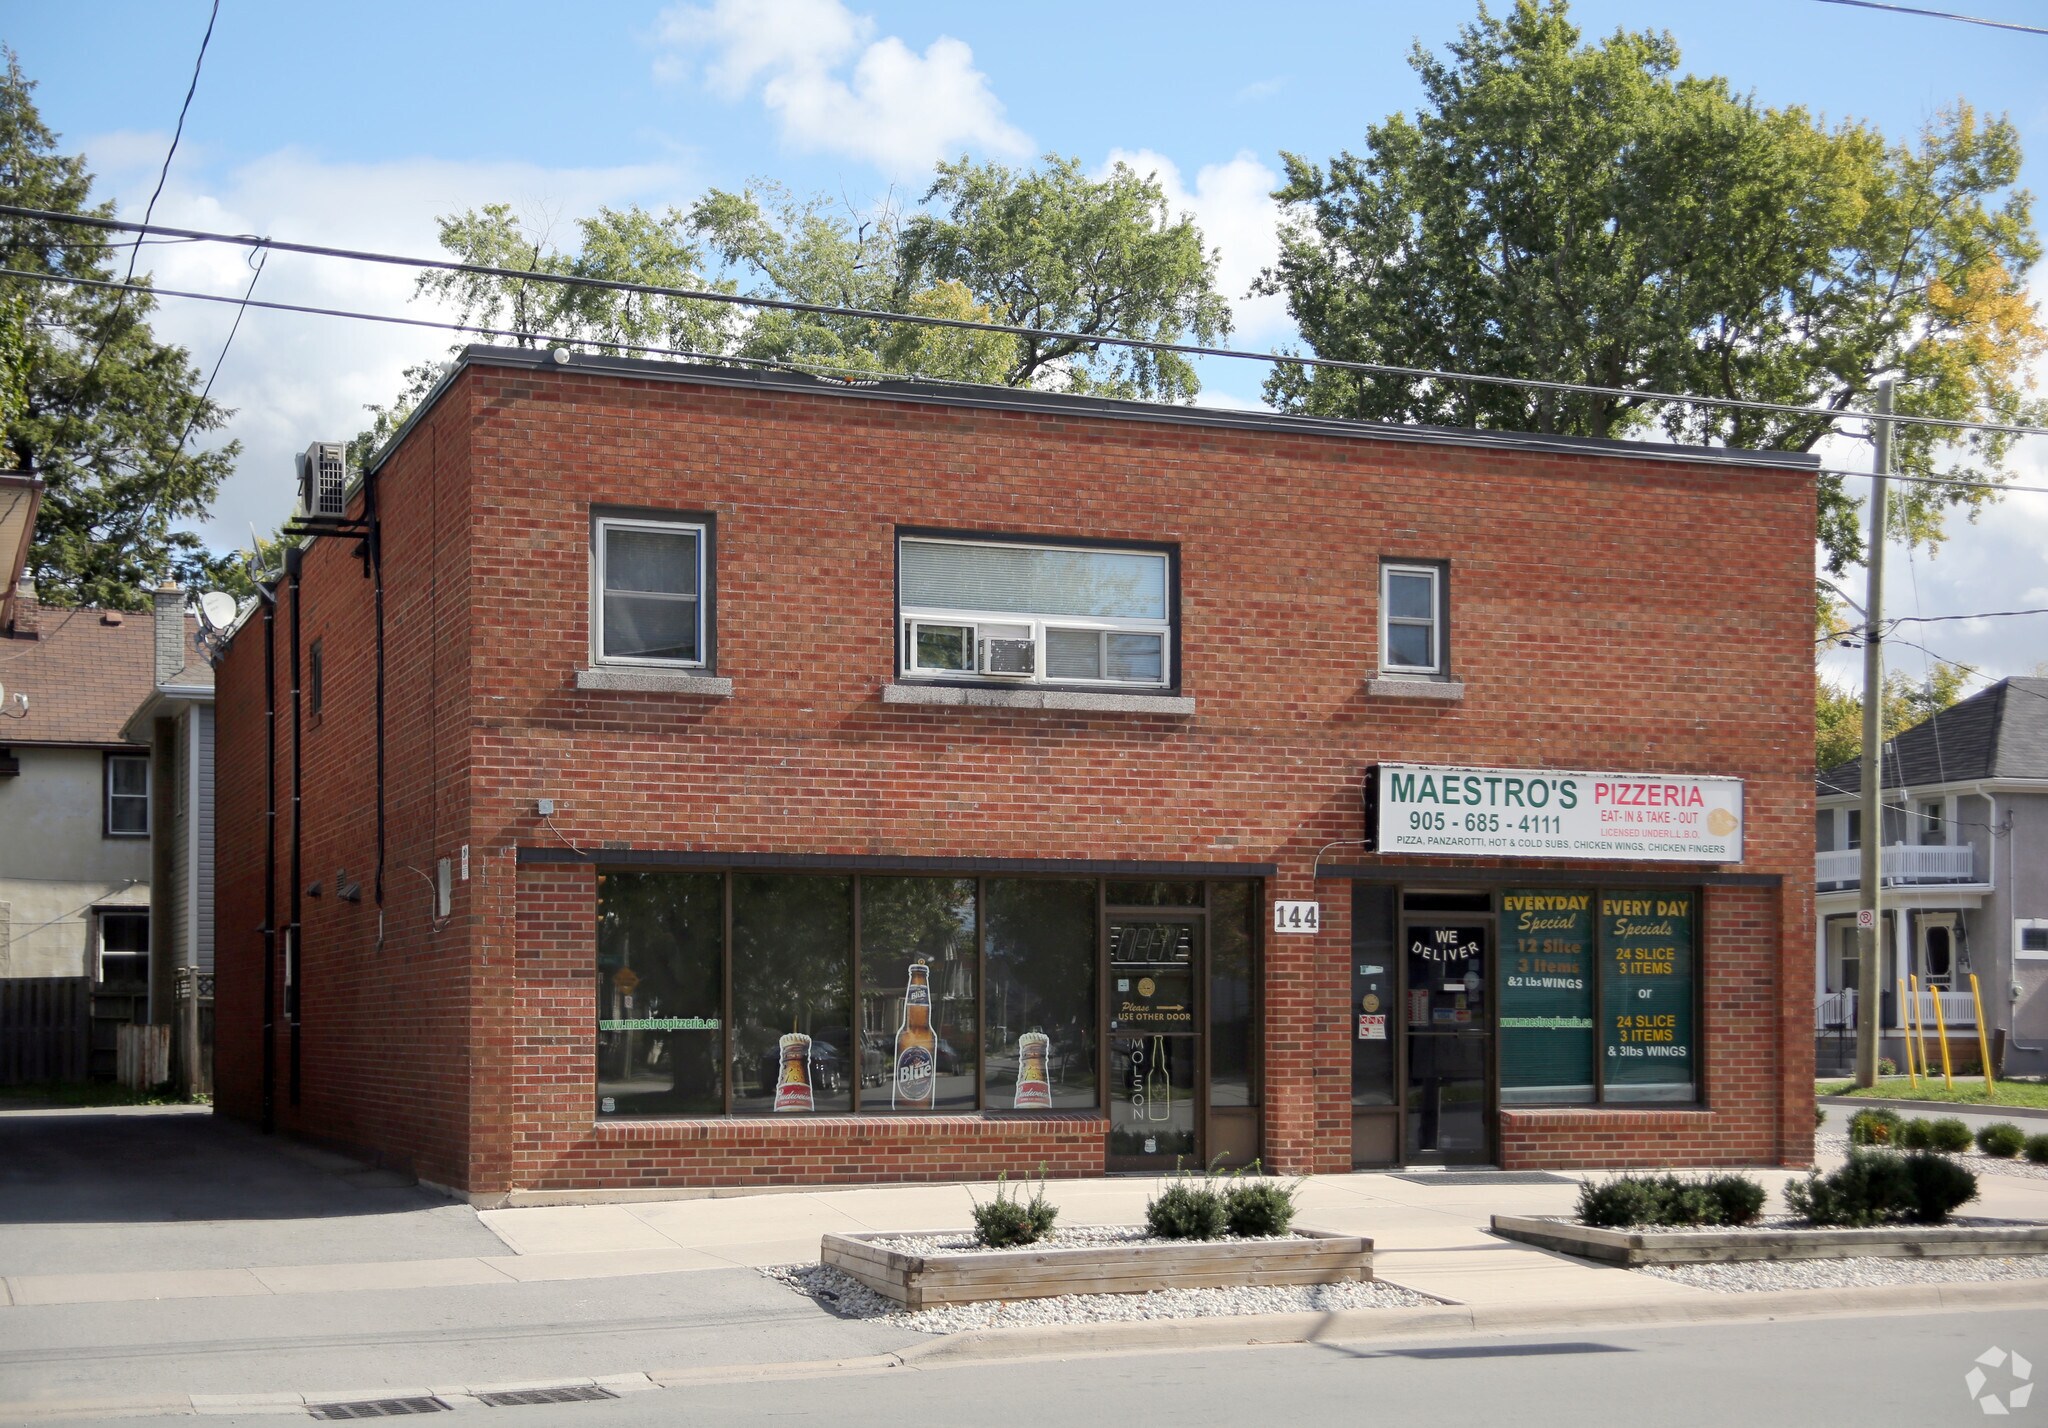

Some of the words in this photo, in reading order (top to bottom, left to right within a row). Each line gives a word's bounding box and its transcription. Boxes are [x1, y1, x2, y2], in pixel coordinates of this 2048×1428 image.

[1391, 773, 1577, 809] MAESTRO'S
[1595, 783, 1704, 807] PIZZERIA
[1410, 811, 1445, 830] 905
[1465, 813, 1499, 832] 685
[1519, 814, 1560, 834] 4111
[1637, 813, 1643, 822] &
[1646, 811, 1670, 823] TAKE
[1679, 812, 1698, 824] OUT
[1601, 828, 1639, 838] LICENSED
[1396, 836, 1425, 845] PIZZA,
[1428, 837, 1486, 847] PANZAROTTI,
[1489, 838, 1507, 847] HOT
[1509, 839, 1516, 847] &
[1518, 839, 1542, 847] COLD
[1545, 840, 1571, 849] SUBS,
[1574, 840, 1612, 850] CHICKEN
[1615, 842, 1645, 851] WINGS,
[1648, 843, 1686, 852] CHICKEN
[1689, 844, 1725, 854] FINGERS
[1504, 896, 1590, 911] EVERYDAY
[1603, 899, 1652, 916] EVERY
[1657, 900, 1688, 916] DAY
[1276, 905, 1317, 928] 144
[1518, 912, 1577, 933] Special
[1614, 918, 1673, 939] Specials
[1435, 930, 1458, 943] WE
[1412, 941, 1479, 961] DELIVER
[1518, 938, 1537, 953] 12
[1543, 938, 1582, 954] Slice
[1616, 948, 1632, 960] 24
[1635, 948, 1675, 960] SLICE
[1518, 959, 1528, 973] 3
[1534, 958, 1580, 974] Items
[1619, 962, 1627, 974] 3
[1631, 962, 1672, 974] ITEMS
[1542, 977, 1583, 989] WINGS
[1638, 989, 1652, 998] or
[1122, 1002, 1150, 1011] Please
[600, 1016, 719, 1031] www.maestrospizzeria.ca
[1136, 1013, 1164, 1021] OTHER
[1167, 1013, 1191, 1021] DOOR
[1617, 1015, 1632, 1028] 24
[1636, 1015, 1676, 1027] SLICE
[1620, 1030, 1628, 1042] 3
[1632, 1029, 1673, 1042] ITEMS
[1608, 1046, 1617, 1056] &
[1620, 1046, 1643, 1056] 3lbs
[1646, 1046, 1686, 1056] WINGS
[900, 1064, 932, 1082] Blue
[1131, 1038, 1144, 1120] MOLSON
